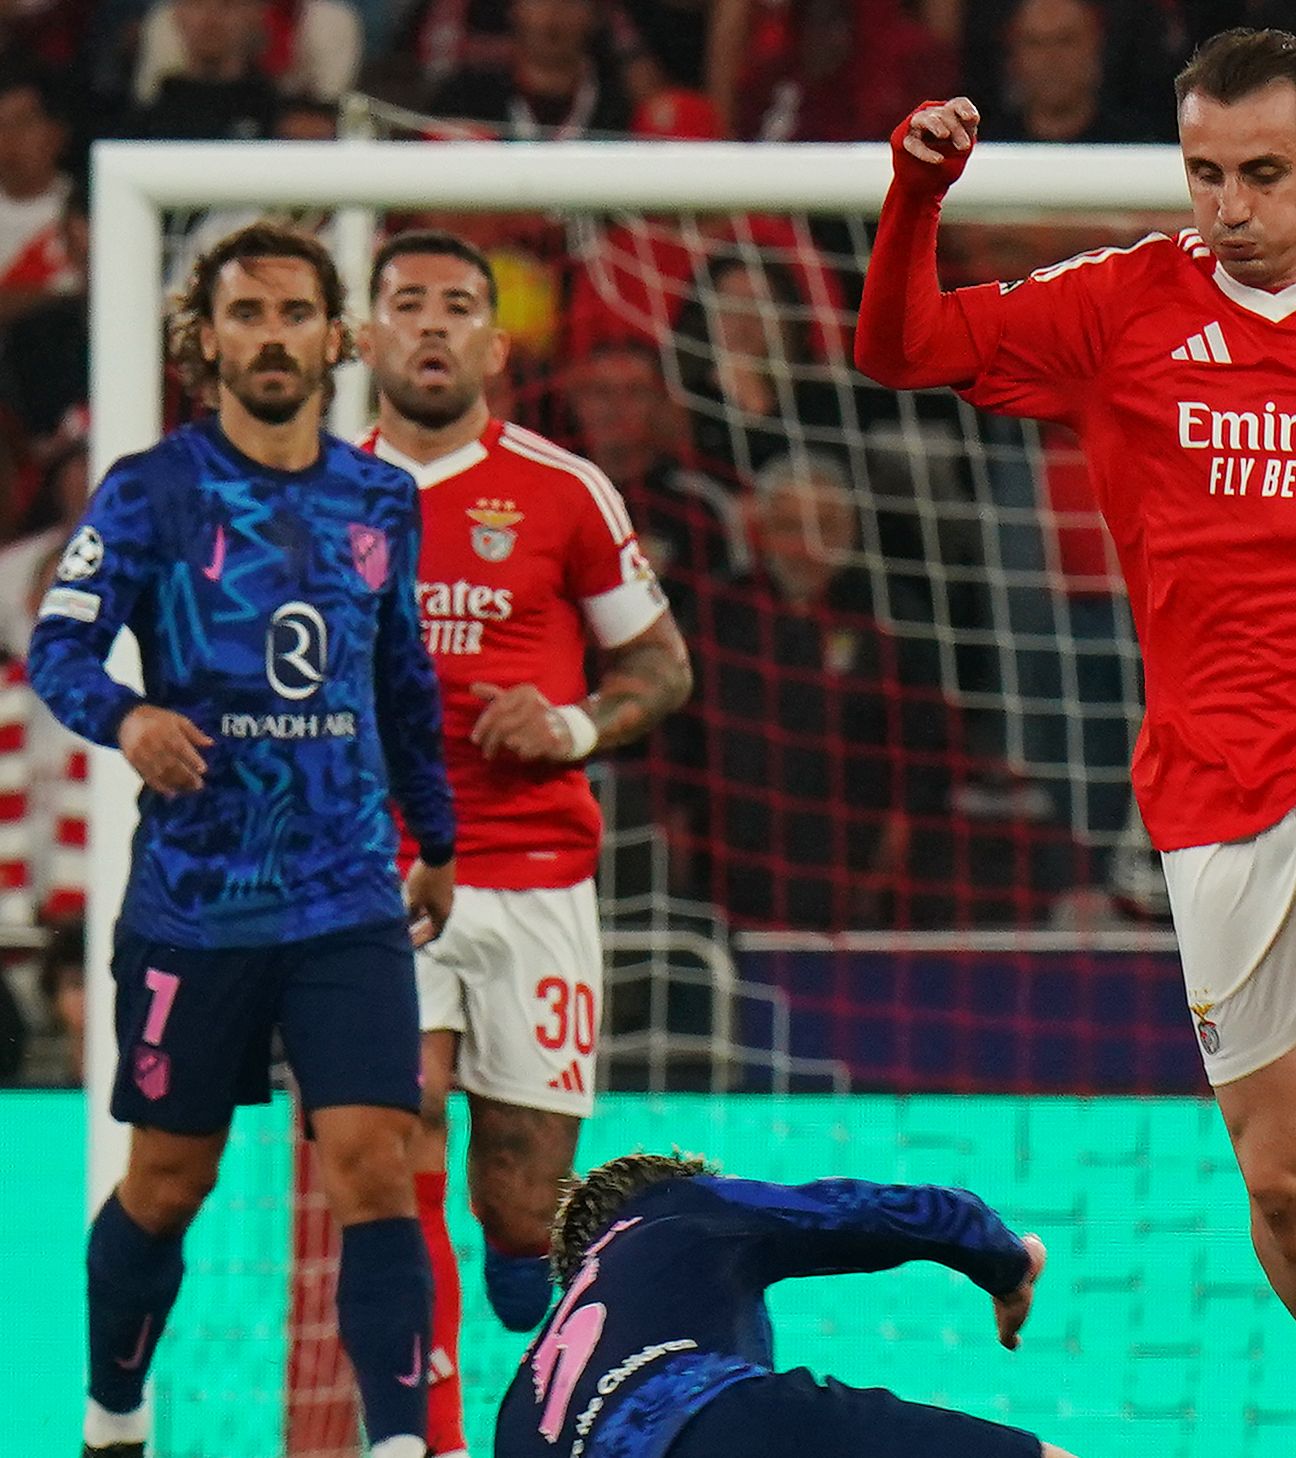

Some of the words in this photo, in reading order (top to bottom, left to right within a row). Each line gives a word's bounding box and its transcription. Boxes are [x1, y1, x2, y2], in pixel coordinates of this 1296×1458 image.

[1209, 457, 1255, 496] FLY
[415, 580, 513, 621] rates
[221, 712, 320, 738] RIYADH
[535, 975, 595, 1056] 30
